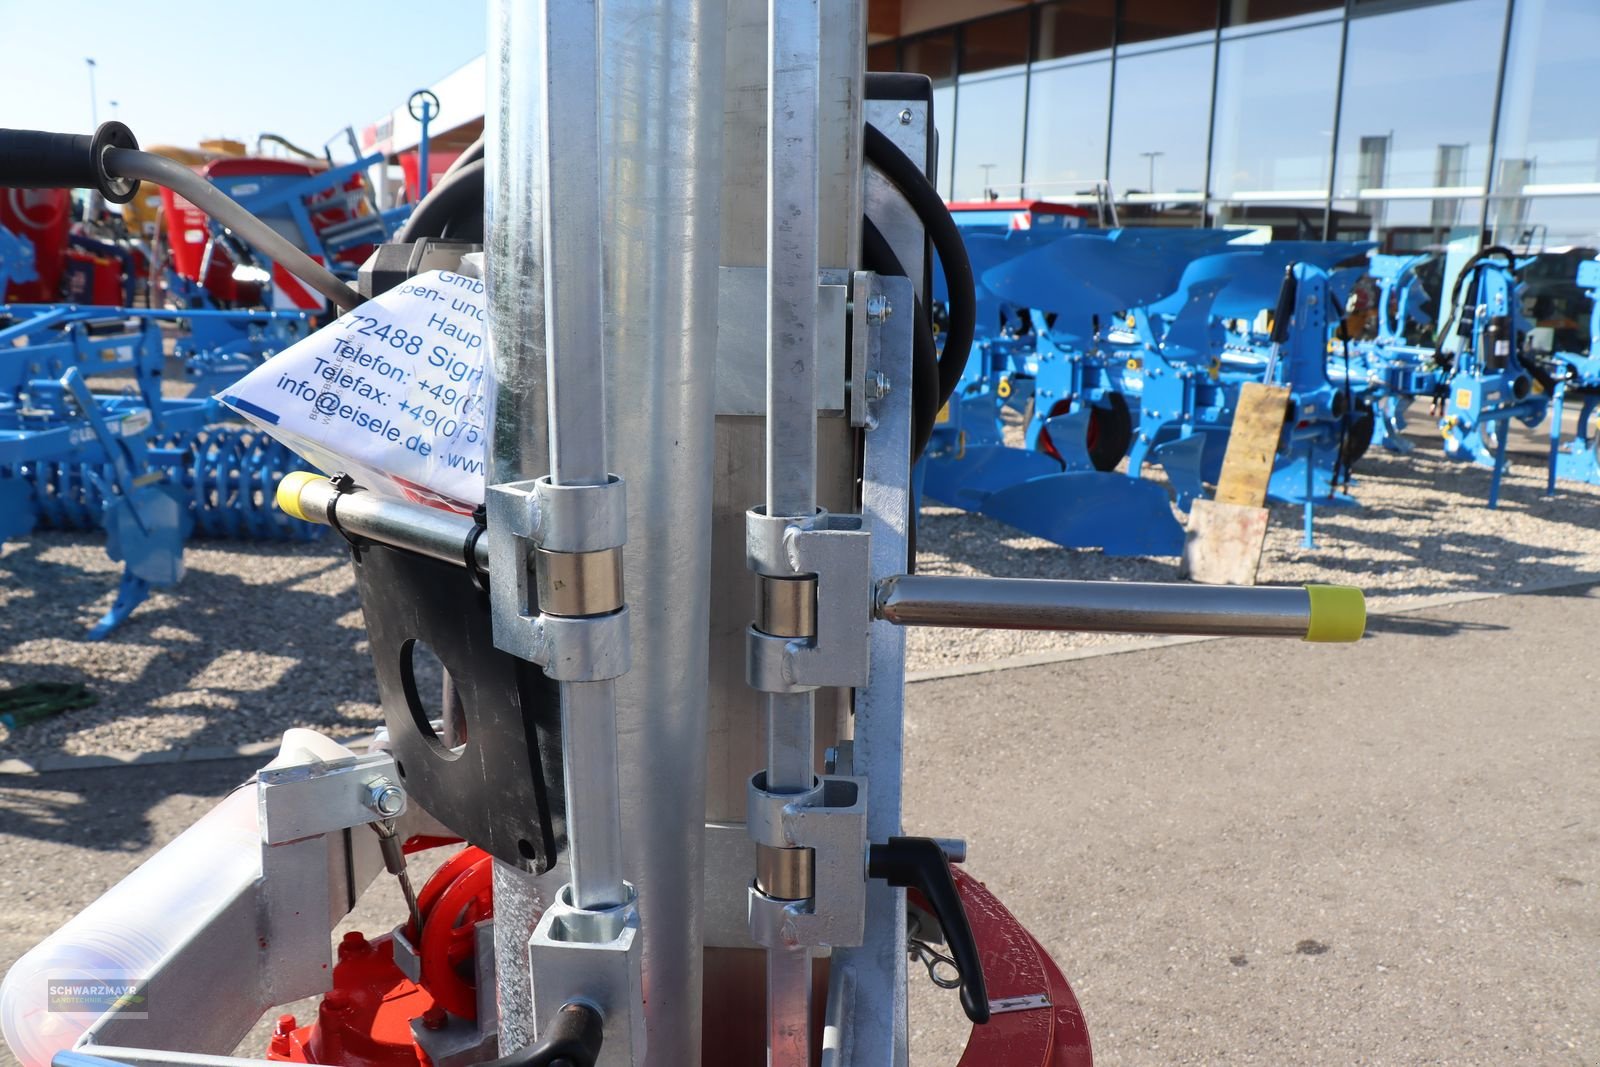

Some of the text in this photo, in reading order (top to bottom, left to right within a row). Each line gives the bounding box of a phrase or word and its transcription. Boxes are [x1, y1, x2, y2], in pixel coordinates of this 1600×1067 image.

[313, 356, 391, 407] Telefax:
[333, 337, 412, 385] Telefon:
[276, 372, 432, 457] info@eisele.de
